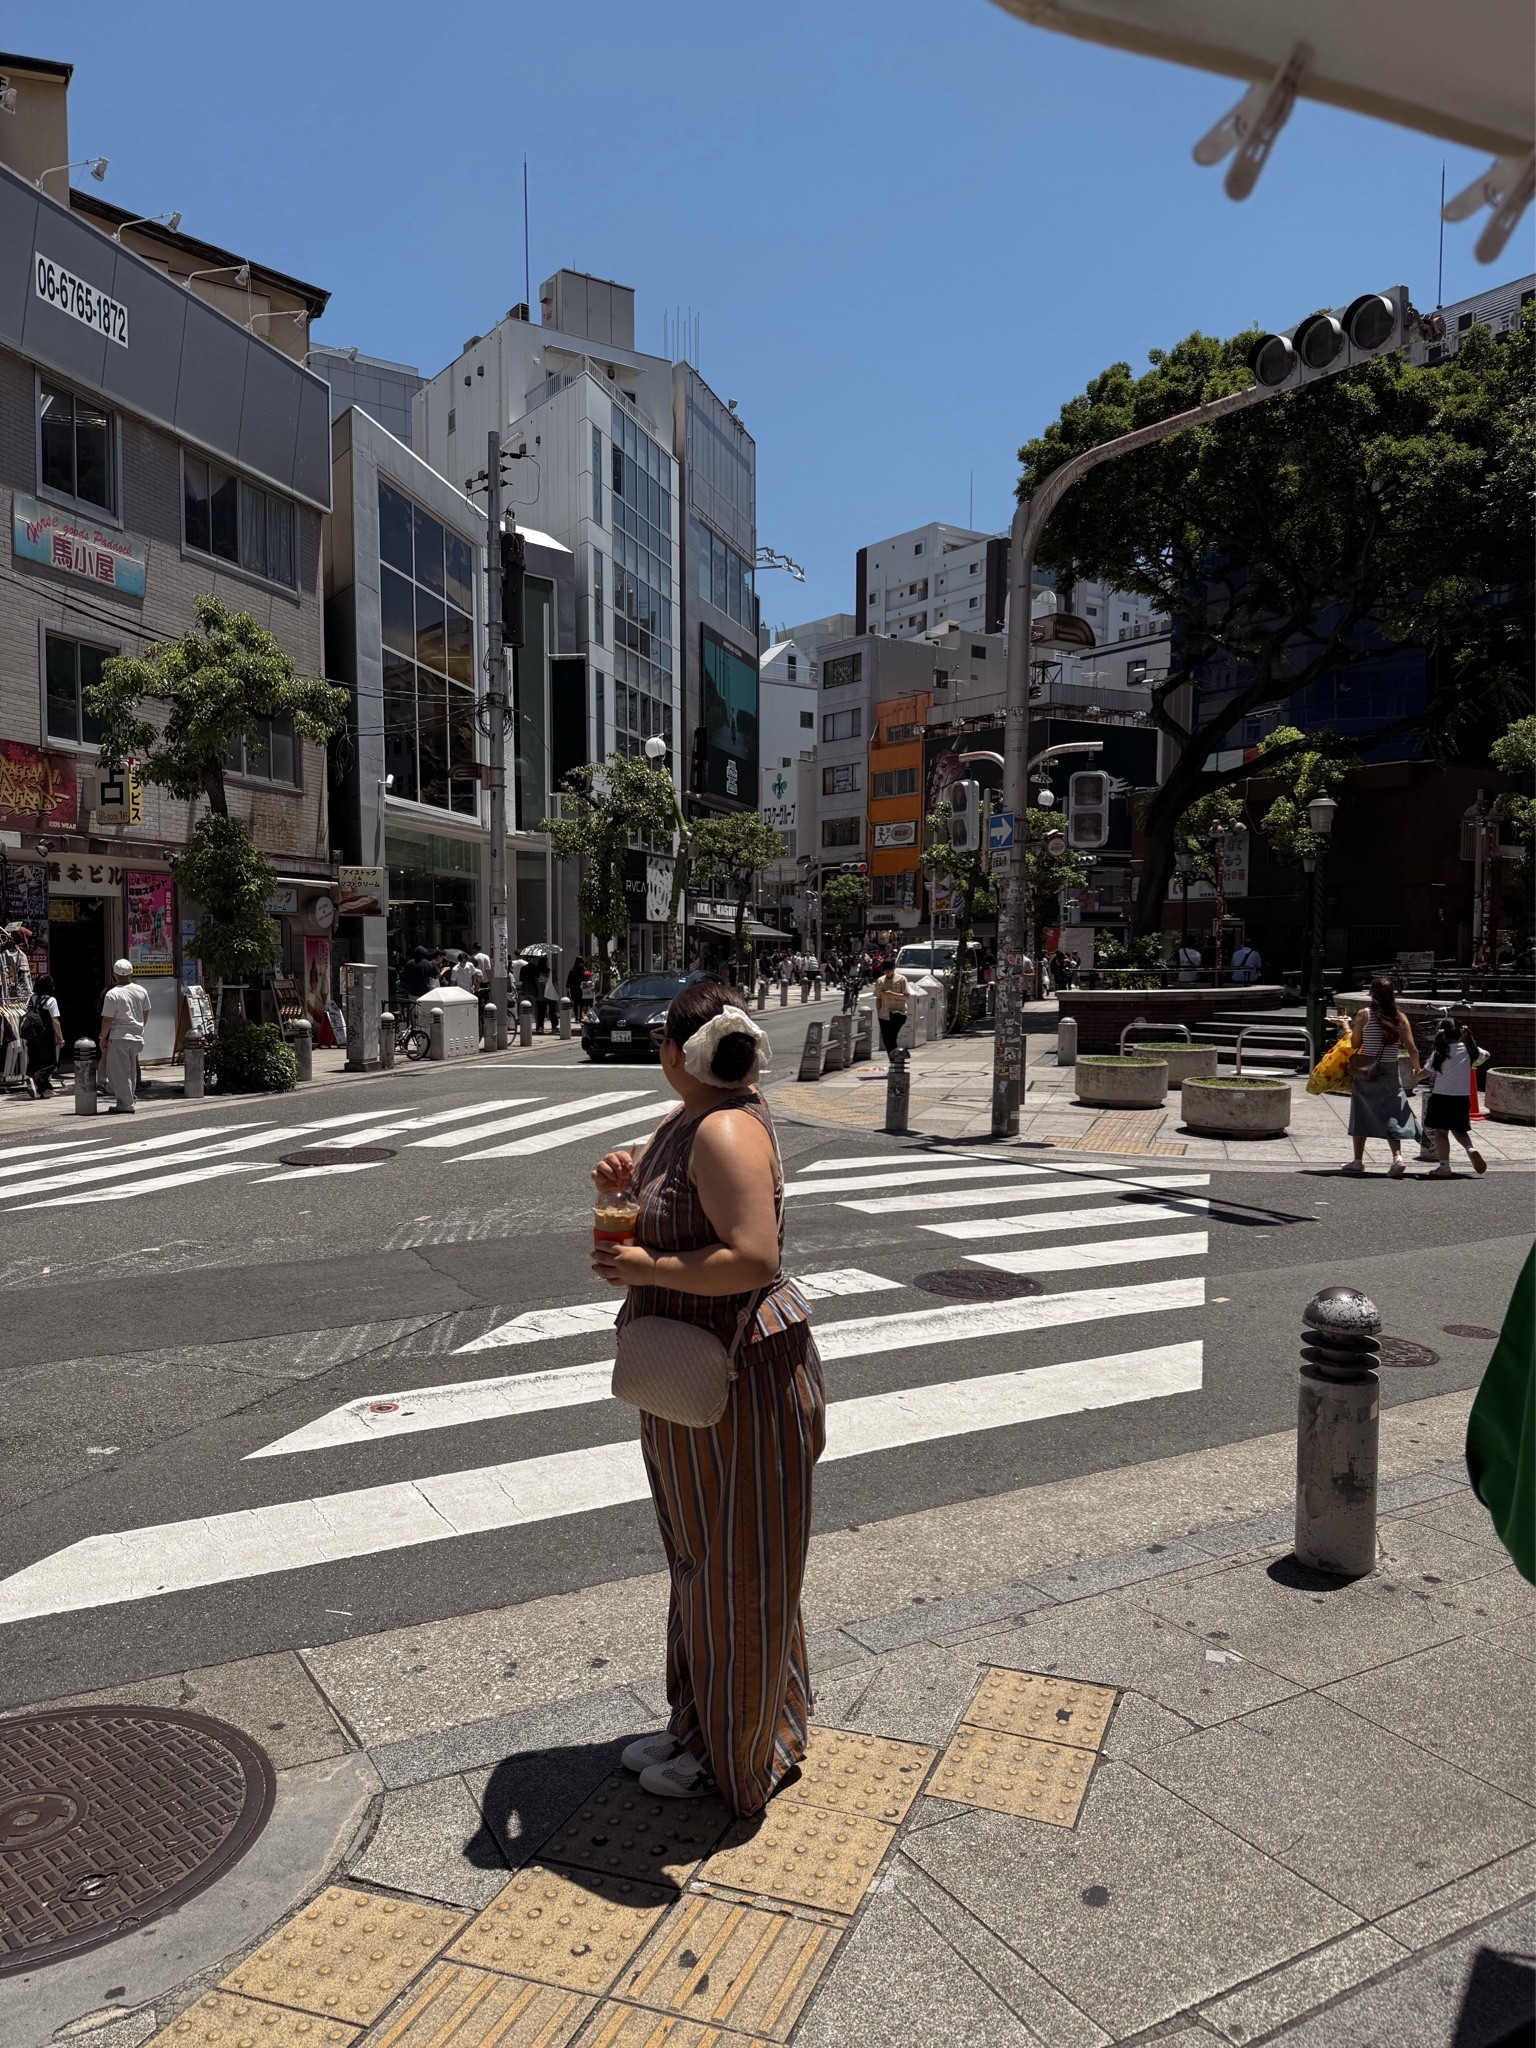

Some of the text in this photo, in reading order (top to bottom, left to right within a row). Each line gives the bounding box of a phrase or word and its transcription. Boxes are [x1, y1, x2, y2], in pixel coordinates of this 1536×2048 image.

[38, 258, 127, 343] 06-6765-1872
[26, 517, 133, 557] Horse goods Paddock
[52, 535, 115, 584] 馬小屋
[118, 811, 128, 820] 1F
[48, 820, 77, 830] KIDS WEAR
[625, 879, 647, 894] RVCA
[696, 902, 711, 915] IKKI
